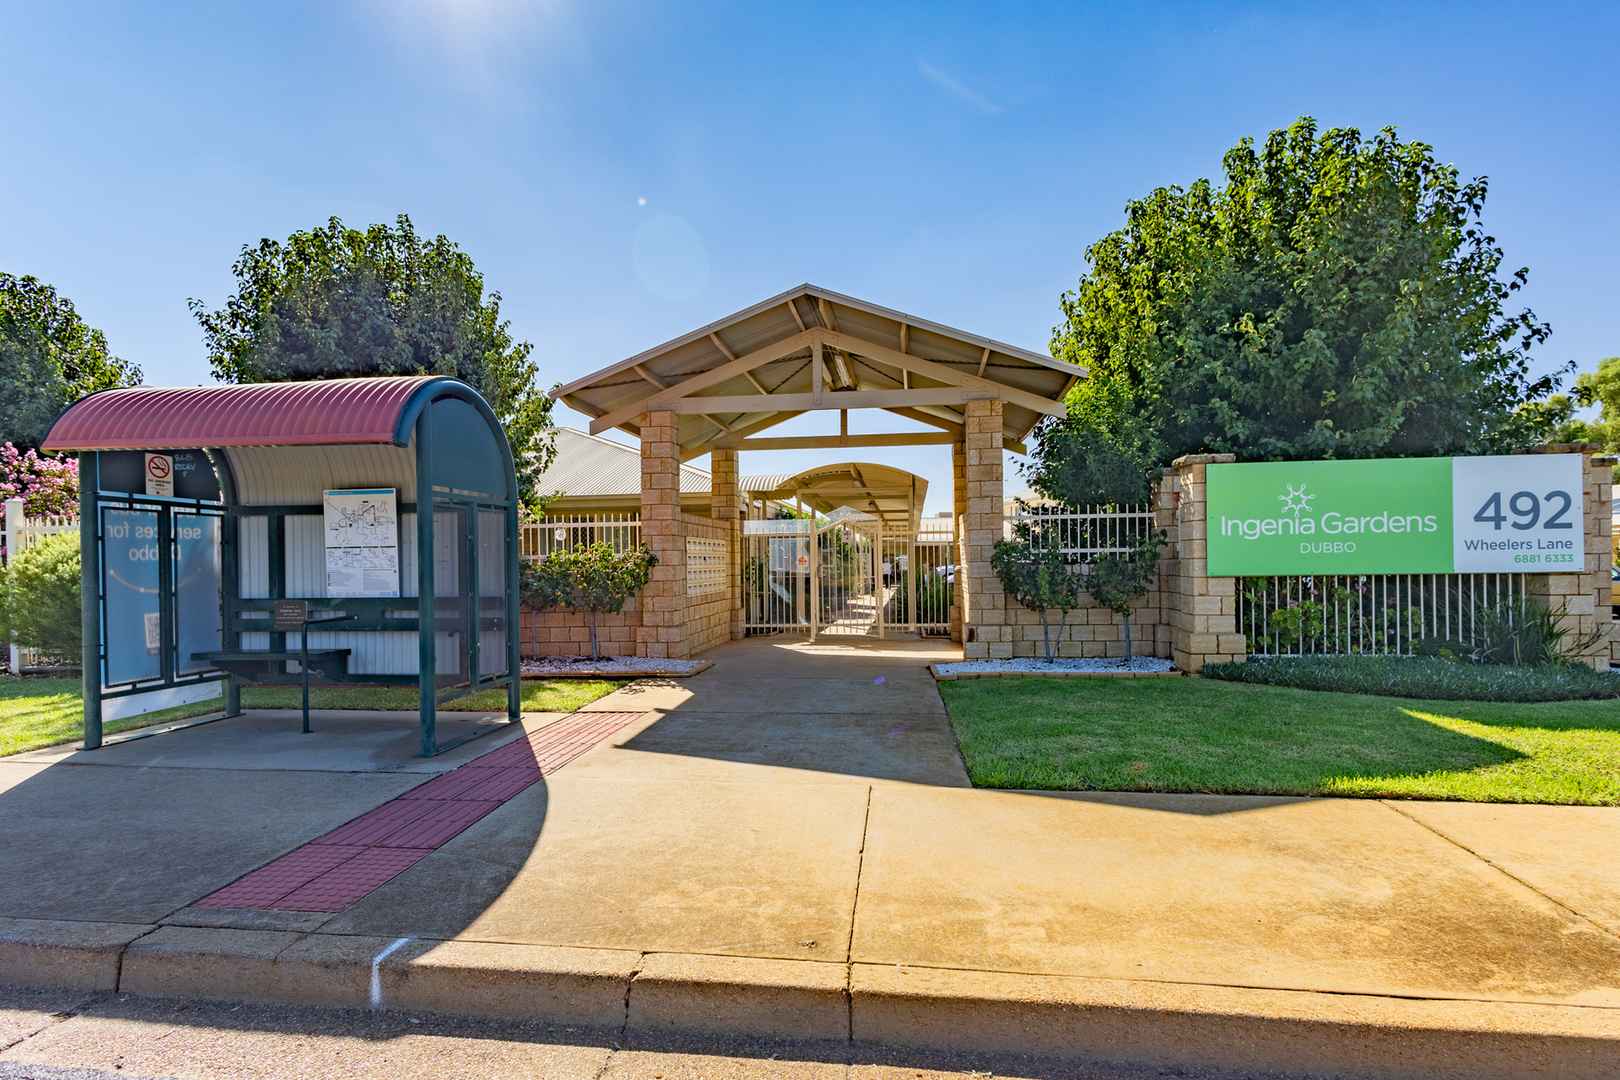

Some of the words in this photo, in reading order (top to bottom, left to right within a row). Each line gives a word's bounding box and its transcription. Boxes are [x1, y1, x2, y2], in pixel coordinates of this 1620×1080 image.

[1473, 490, 1573, 530] 492
[1220, 515, 1315, 539] Ingenia
[1320, 511, 1438, 534] Gardens
[1299, 541, 1356, 554] DUBBO
[1464, 539, 1533, 551] Wheelers
[1537, 538, 1574, 550] Lane
[1513, 554, 1541, 564] 6881
[1544, 553, 1574, 563] 6333
